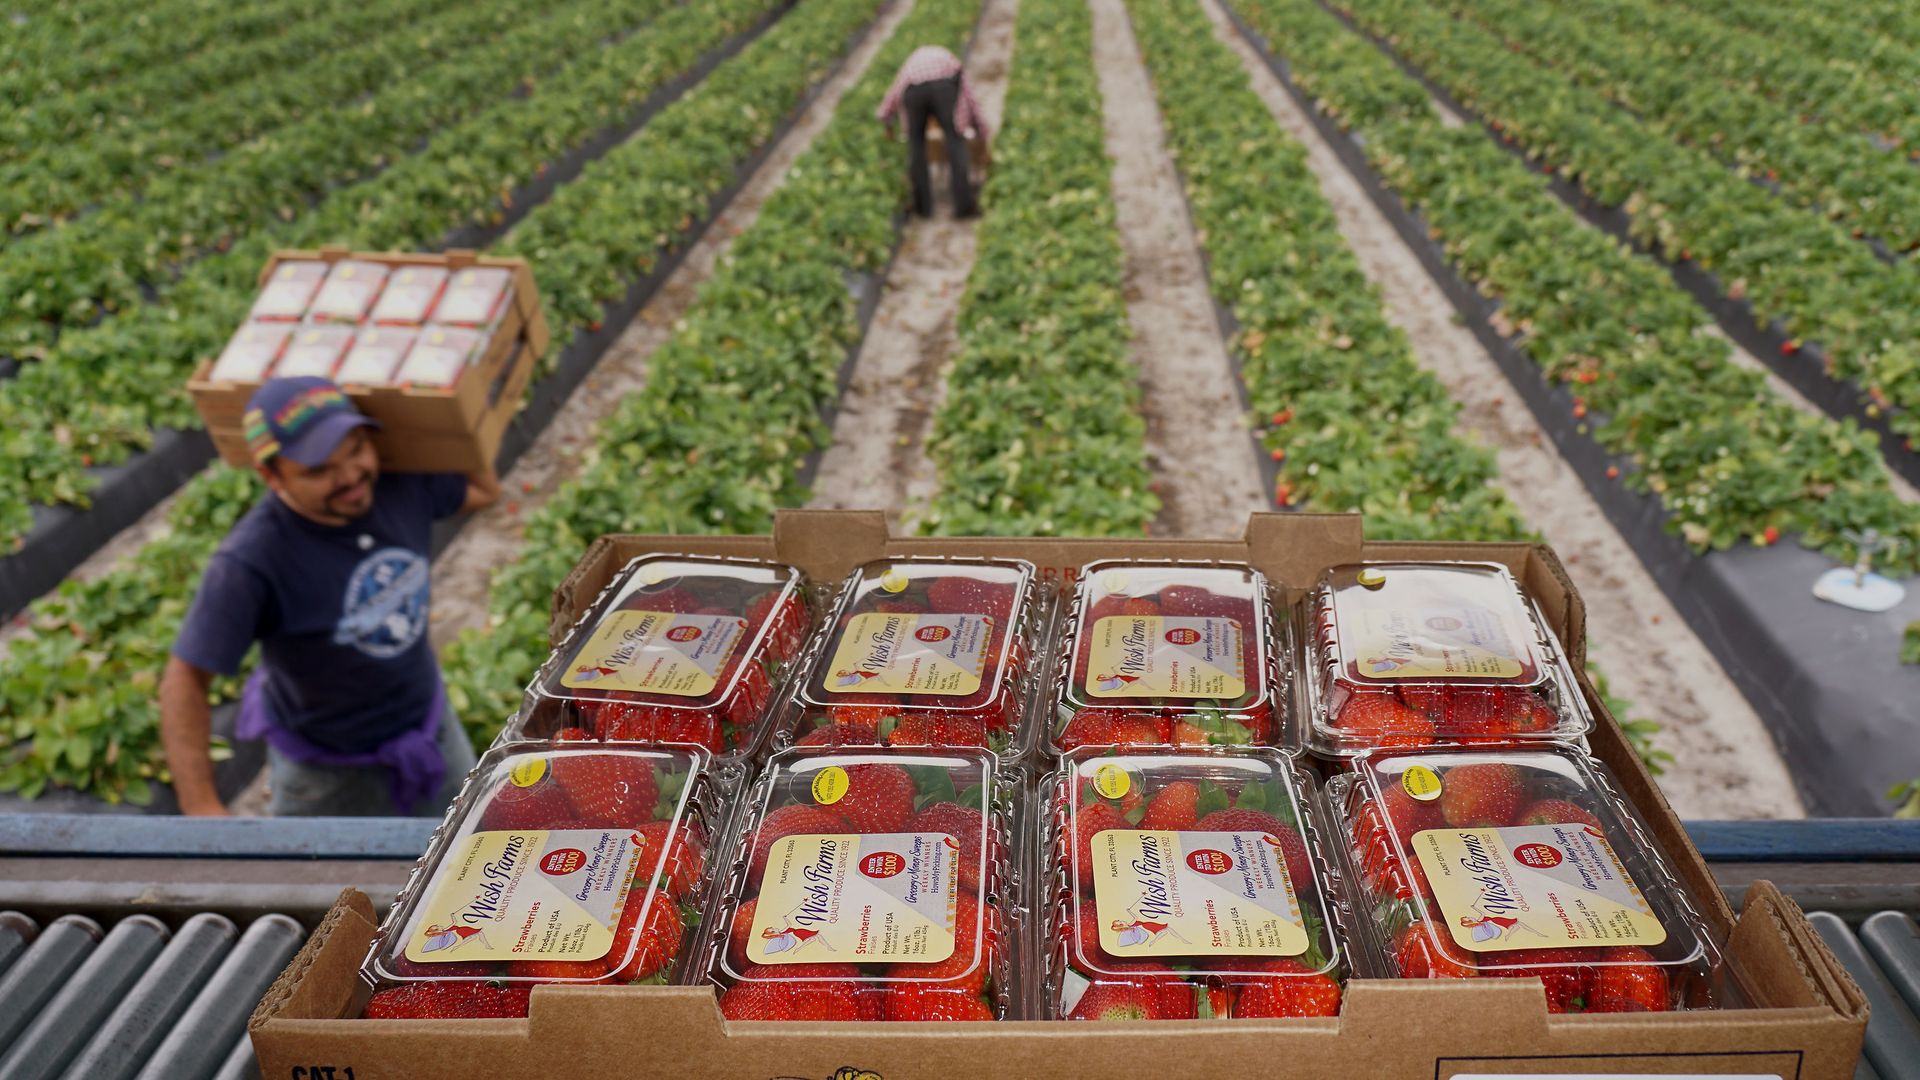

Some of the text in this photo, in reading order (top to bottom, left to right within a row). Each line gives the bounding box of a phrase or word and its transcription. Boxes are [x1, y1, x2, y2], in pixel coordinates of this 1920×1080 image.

[623, 616, 656, 641] Farms
[872, 616, 900, 644] Farms
[862, 645, 890, 670] Wish
[1120, 619, 1146, 674] Wish Farms
[904, 658, 921, 688] Strawberries
[1169, 662, 1178, 692] Strawberries
[457, 866, 470, 880] PLANT
[547, 855, 559, 870] ENTER
[562, 851, 581, 872] $100!
[576, 833, 611, 901] Grocery Money Sweeps
[594, 838, 618, 890] WEEKLY WINNERS
[780, 870, 788, 883] PLANT
[803, 839, 837, 882] Farms
[868, 858, 876, 873] ENTER
[884, 855, 898, 875] $100!
[904, 836, 925, 903] Grocery Money Sweeps
[921, 842, 931, 893] WEEKLY WINNERS
[1132, 835, 1171, 919] Wish Farms
[1161, 837, 1184, 917] QUALITY PRODUCE SINCE 1922
[1210, 852, 1226, 872] $100!
[1245, 840, 1263, 889] WEEKLY WINNERS
[1459, 833, 1518, 914] Wish Farms
[462, 836, 524, 923] Wish Farms
[494, 837, 538, 921] QUALITY PRODUCE SINCE 1922
[828, 841, 850, 923] QUALITY PRODUCE SINCE 1922
[795, 884, 829, 925] Wish
[885, 912, 893, 923] USA
[1230, 907, 1239, 918] USA
[1544, 893, 1579, 939] Strawberries
[511, 903, 542, 952] Strawberries
[537, 931, 553, 952] Product
[549, 910, 560, 921] USA
[855, 905, 872, 954] Strawberries
[1203, 900, 1222, 947] Strawberries
[1234, 927, 1246, 947] Product
[524, 934, 538, 952] Fraises
[558, 943, 567, 952] Net
[868, 936, 877, 954] Fraises
[882, 933, 891, 954] Product
